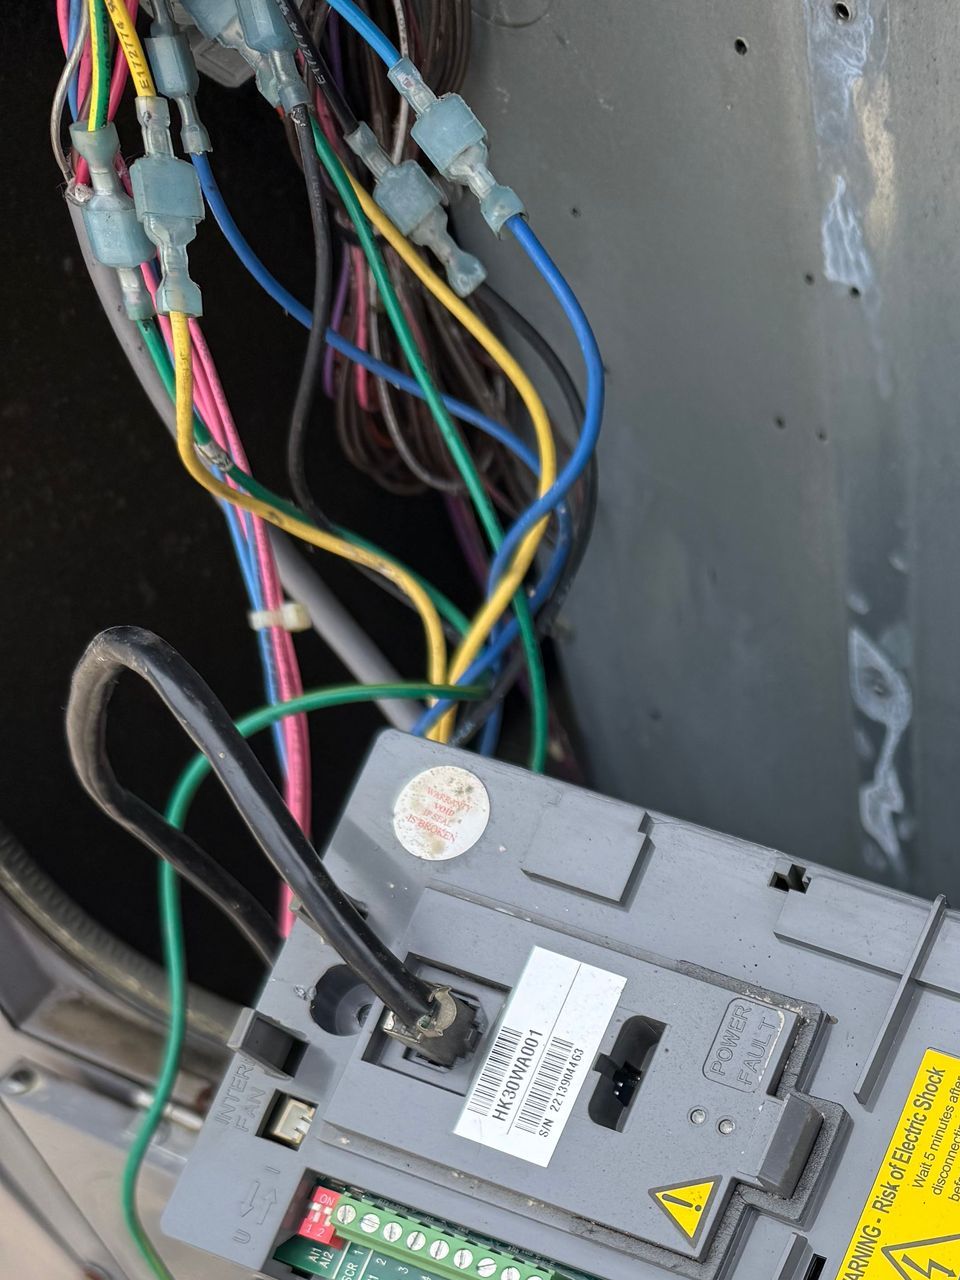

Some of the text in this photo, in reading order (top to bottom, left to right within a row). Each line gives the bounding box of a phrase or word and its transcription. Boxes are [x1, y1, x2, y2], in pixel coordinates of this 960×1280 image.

[710, 1005, 752, 1076] POWER
[737, 1016, 776, 1086] FAULT
[492, 1029, 543, 1121] HK30WA001
[538, 1048, 584, 1138] S/N 2213904463
[913, 1066, 946, 1111] Shock
[234, 1086, 266, 1133] FAN
[930, 1104, 955, 1152] minutes
[892, 1112, 927, 1165] Electric
[925, 1152, 936, 1161] 5
[891, 1161, 905, 1181] of
[912, 1161, 932, 1188] Wait
[320, 1194, 335, 1205] ON
[871, 1181, 898, 1214] Risk
[316, 1228, 326, 1237] 2
[375, 1258, 387, 1266] 2
[398, 1266, 409, 1274] 3
